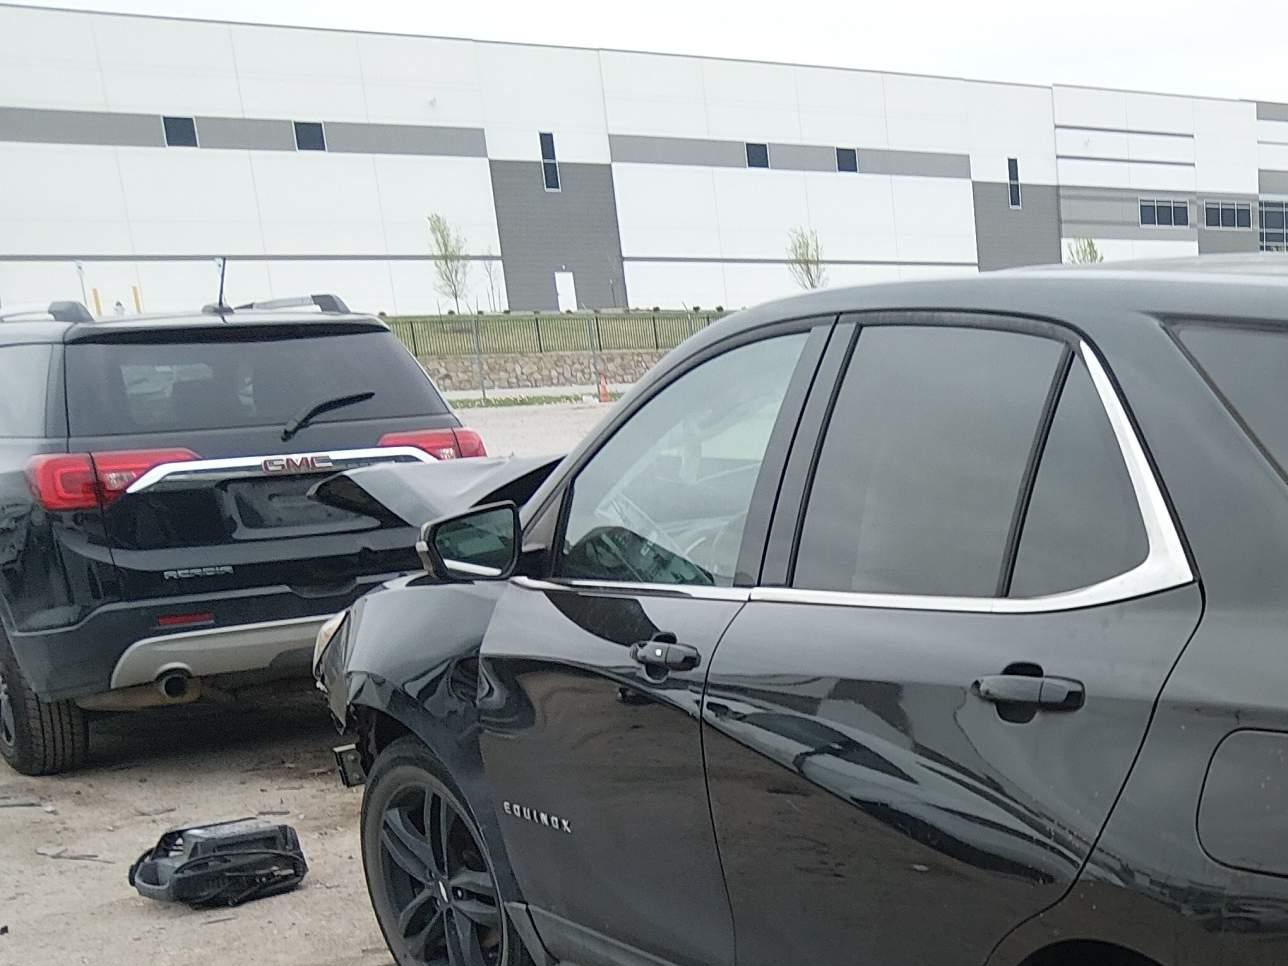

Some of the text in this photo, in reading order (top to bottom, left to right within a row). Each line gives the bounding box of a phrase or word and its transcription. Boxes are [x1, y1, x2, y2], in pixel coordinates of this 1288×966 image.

[262, 454, 333, 472] GMC
[164, 565, 233, 580] ACADIA
[503, 800, 572, 833] EQUINOX
